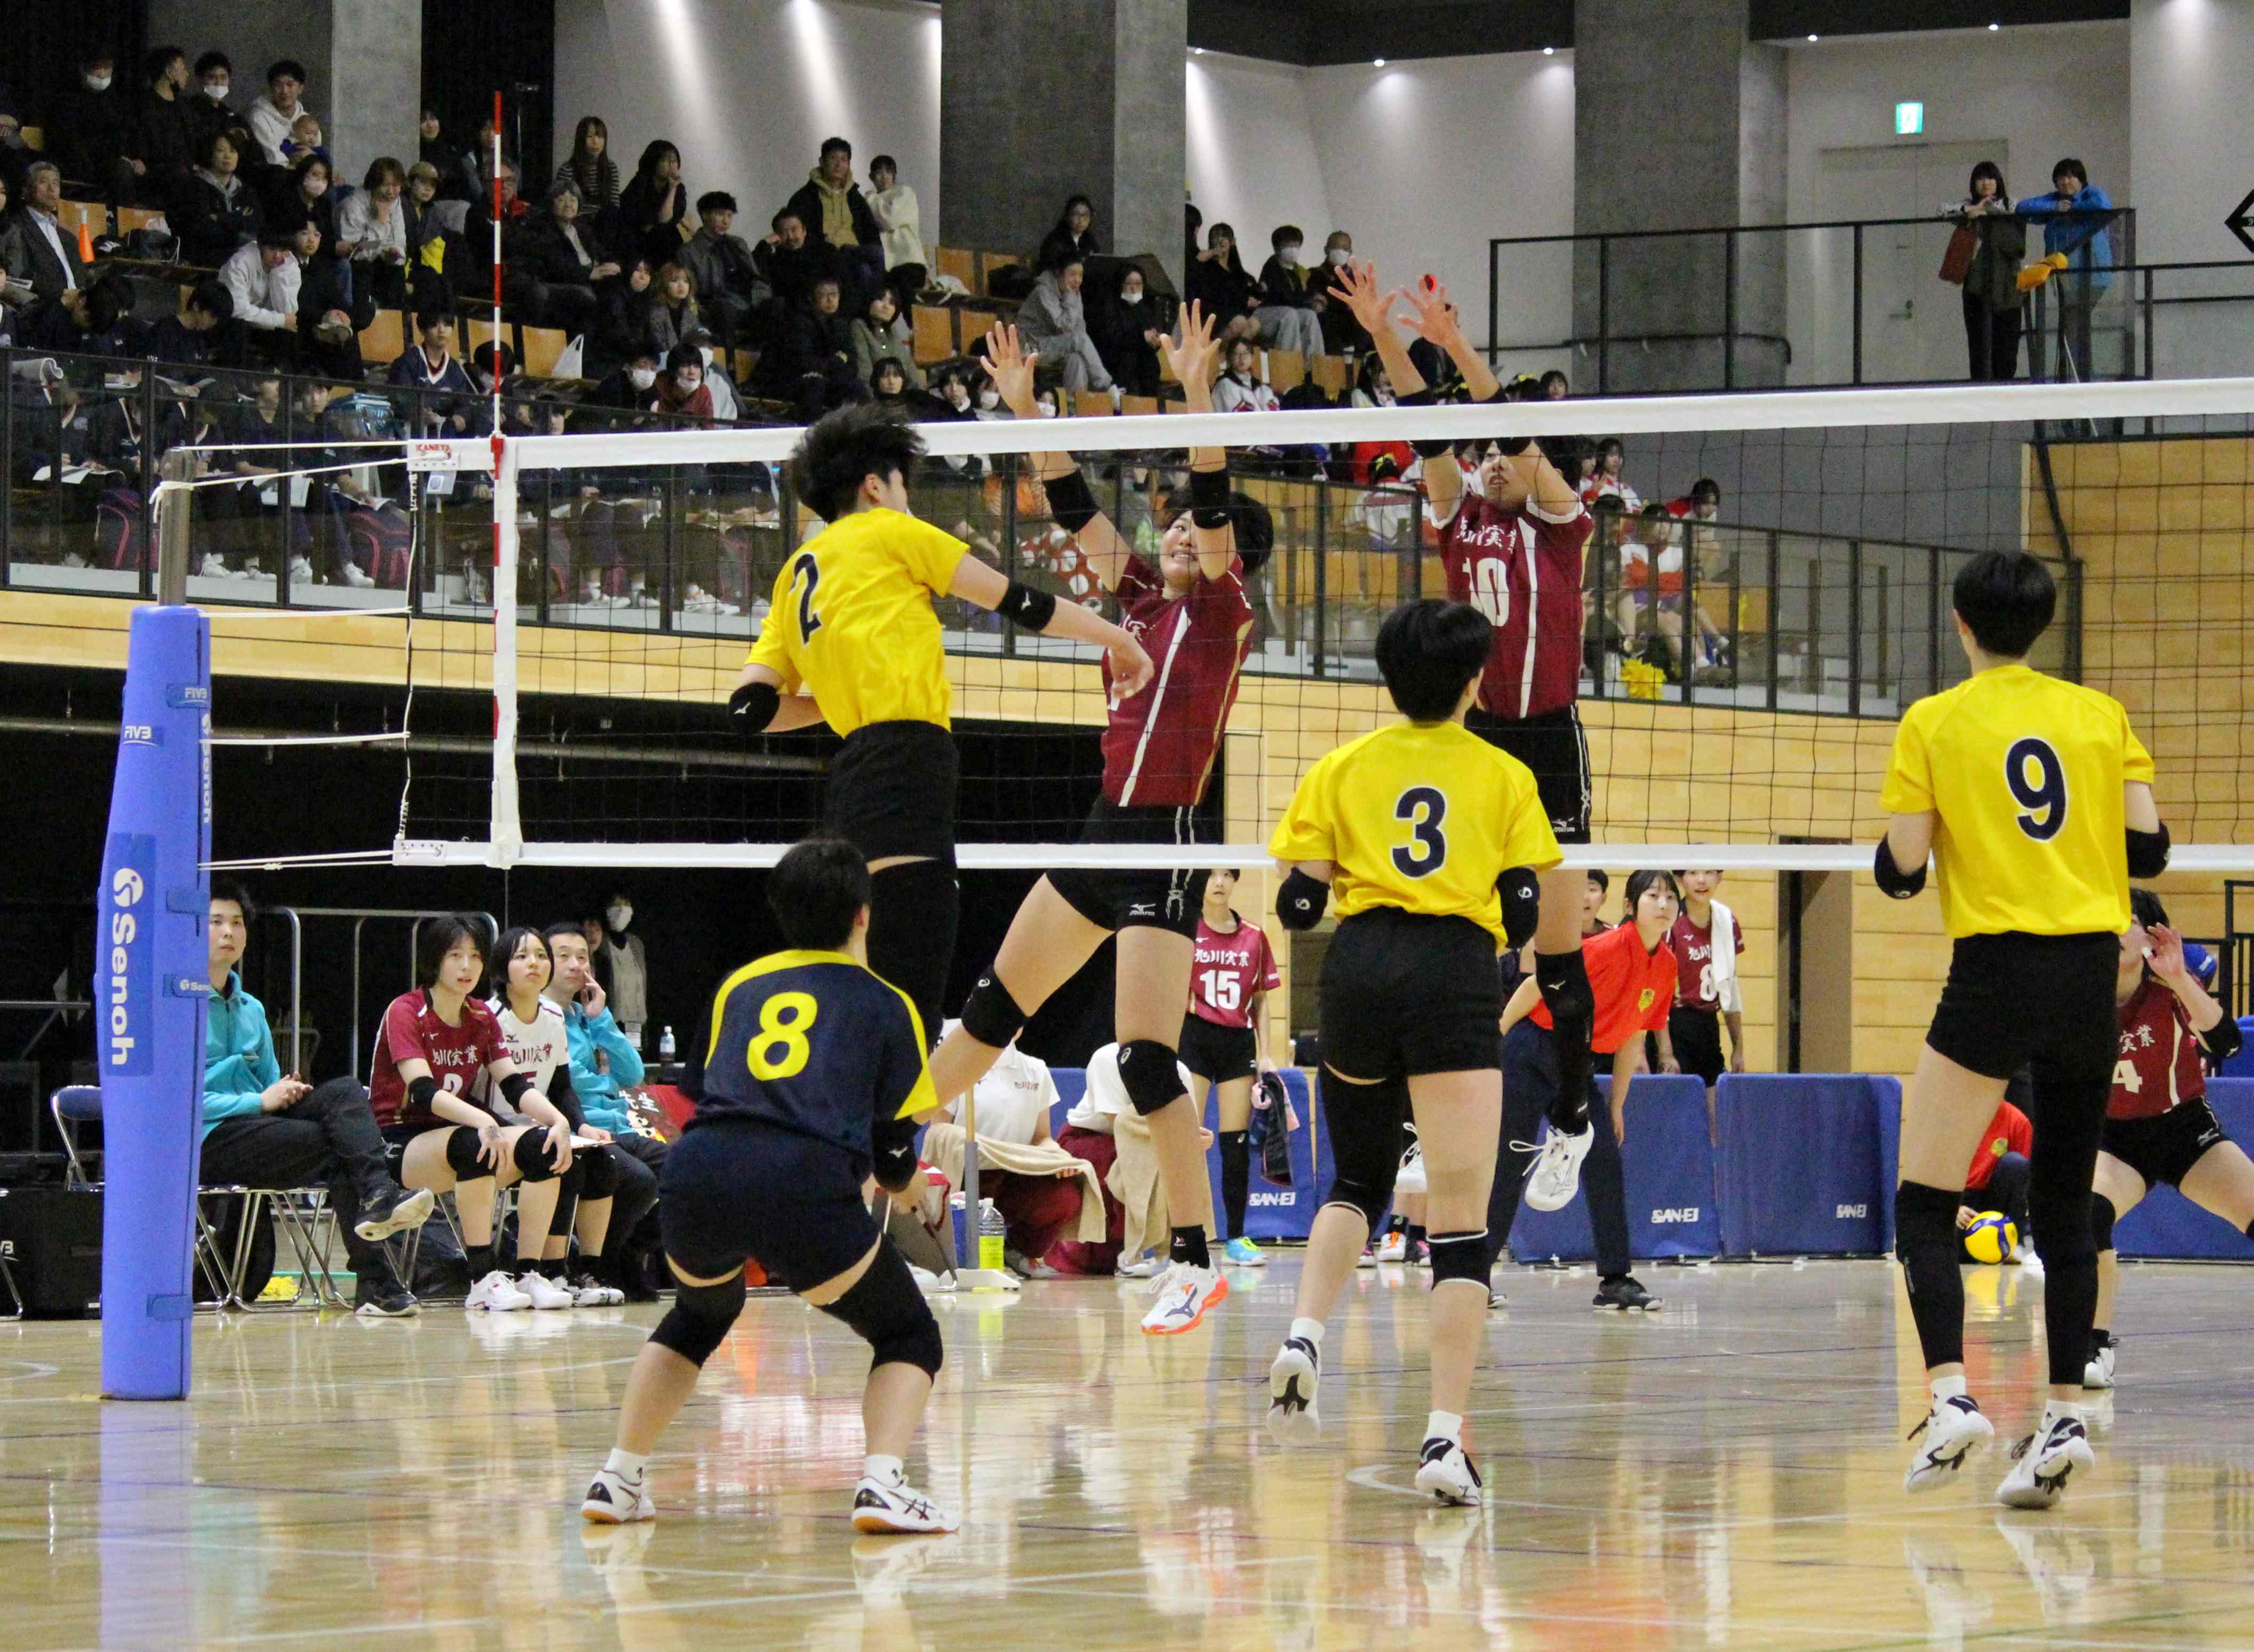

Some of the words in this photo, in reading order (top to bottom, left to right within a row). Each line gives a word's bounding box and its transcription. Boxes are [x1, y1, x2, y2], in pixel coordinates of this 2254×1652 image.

[416, 444, 452, 453] KANEYA
[788, 552, 822, 648] 2
[1462, 557, 1510, 627] 10
[124, 725, 152, 739] FIVB
[2004, 737, 2067, 842] 9
[1391, 786, 1447, 879] 3
[111, 913, 136, 1065] Senoh
[1199, 969, 1241, 1010] 15
[1699, 963, 1717, 1001] 8
[747, 991, 818, 1081] 8
[2112, 1059, 2143, 1094] 4
